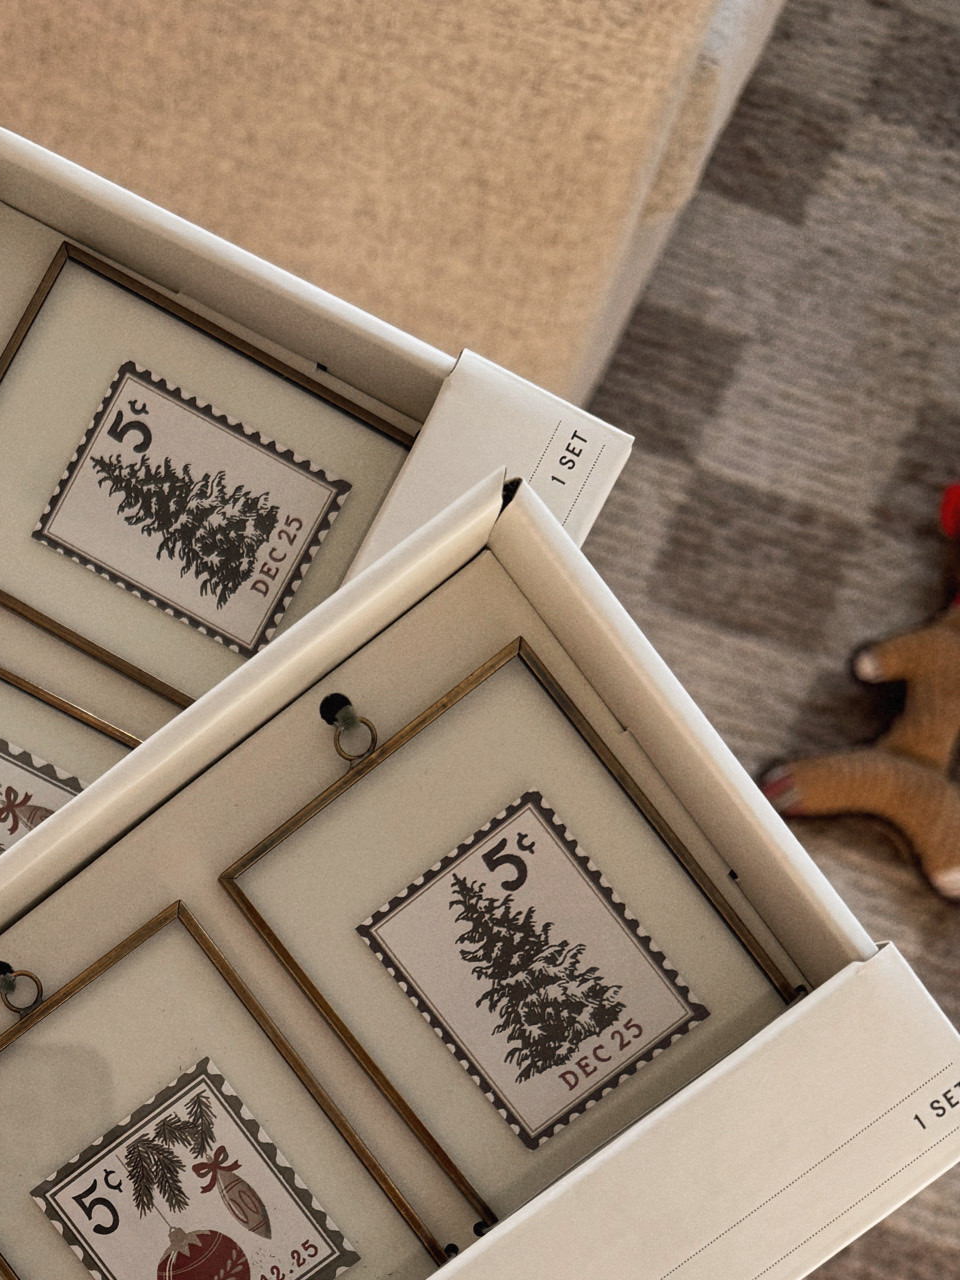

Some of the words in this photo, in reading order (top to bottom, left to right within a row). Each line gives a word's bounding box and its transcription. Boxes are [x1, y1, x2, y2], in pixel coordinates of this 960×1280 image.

[558, 429, 588, 470] SET
[551, 475, 566, 486] 1
[250, 547, 287, 598] DEC
[277, 514, 304, 547] 25
[558, 1044, 612, 1091] DEC
[610, 1018, 643, 1052] 25
[913, 1113, 927, 1130] 1
